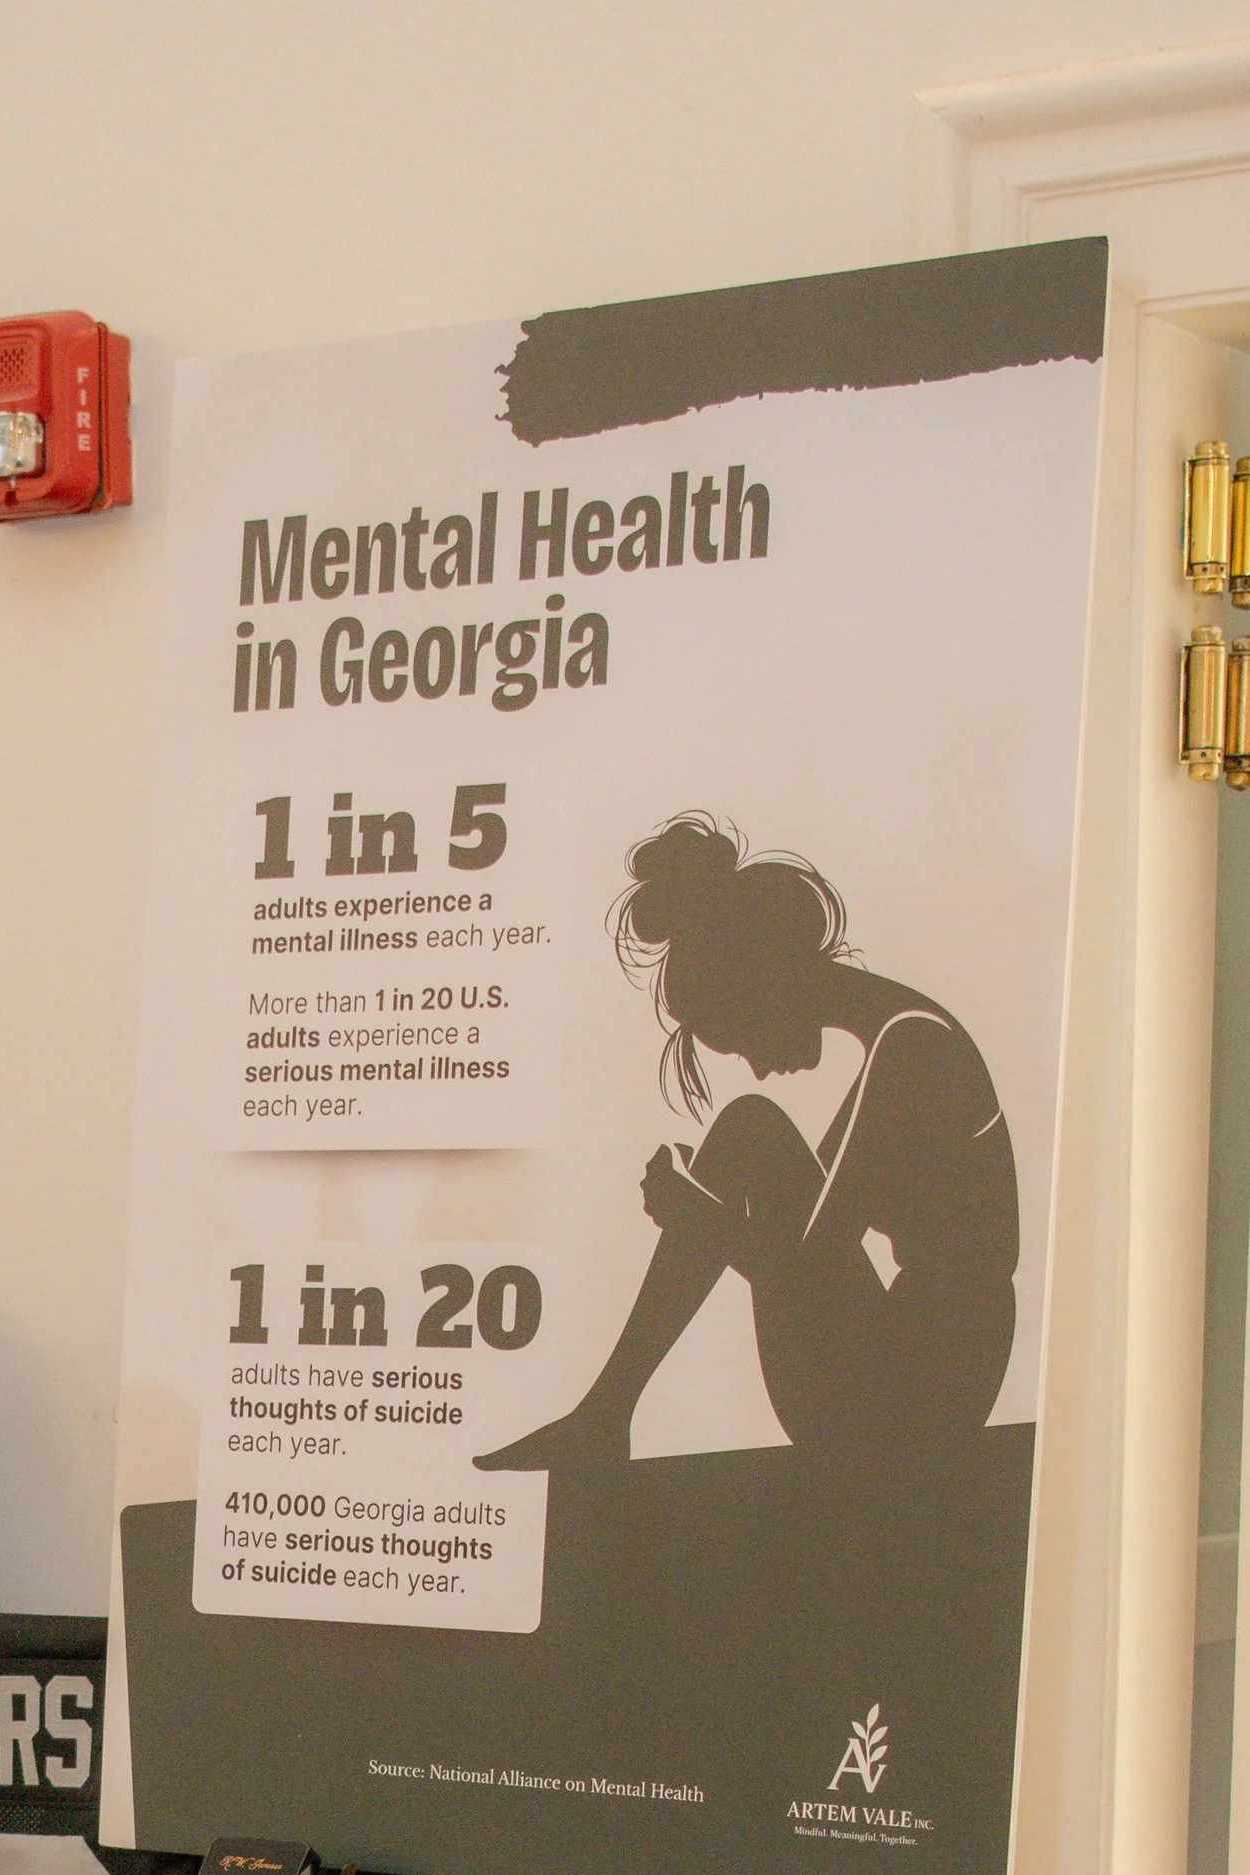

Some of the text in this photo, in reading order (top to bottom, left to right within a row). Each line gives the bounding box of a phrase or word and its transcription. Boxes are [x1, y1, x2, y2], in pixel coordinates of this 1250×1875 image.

[75, 367, 91, 451] FIRE
[240, 464, 770, 606] Mental Health
[234, 594, 609, 712] in Georgia
[254, 783, 508, 880] 1 in 5
[254, 891, 493, 921] adults experience a
[252, 923, 551, 954] mental illness each year.
[249, 984, 510, 1015] More than 1 in 20 U.S.
[246, 1023, 480, 1053] adults experience a
[245, 1055, 510, 1084] serious mental illness
[243, 1094, 363, 1122] each year.
[229, 1263, 543, 1351] 1 in 20
[231, 1363, 463, 1390] adults have serious
[230, 1396, 463, 1426] thoughts of suicide
[227, 1430, 347, 1461] each year.
[225, 1491, 506, 1528] 410,000 Georgia adults
[223, 1524, 493, 1564] have serious thoughts
[221, 1557, 465, 1596] of suicide each year.
[368, 1759, 704, 1803] Source: National Alliance on Mental Health
[786, 1801, 935, 1830] ARTEM VALE INC.
[794, 1826, 918, 1846] Mindful. Meaningful. Together.
